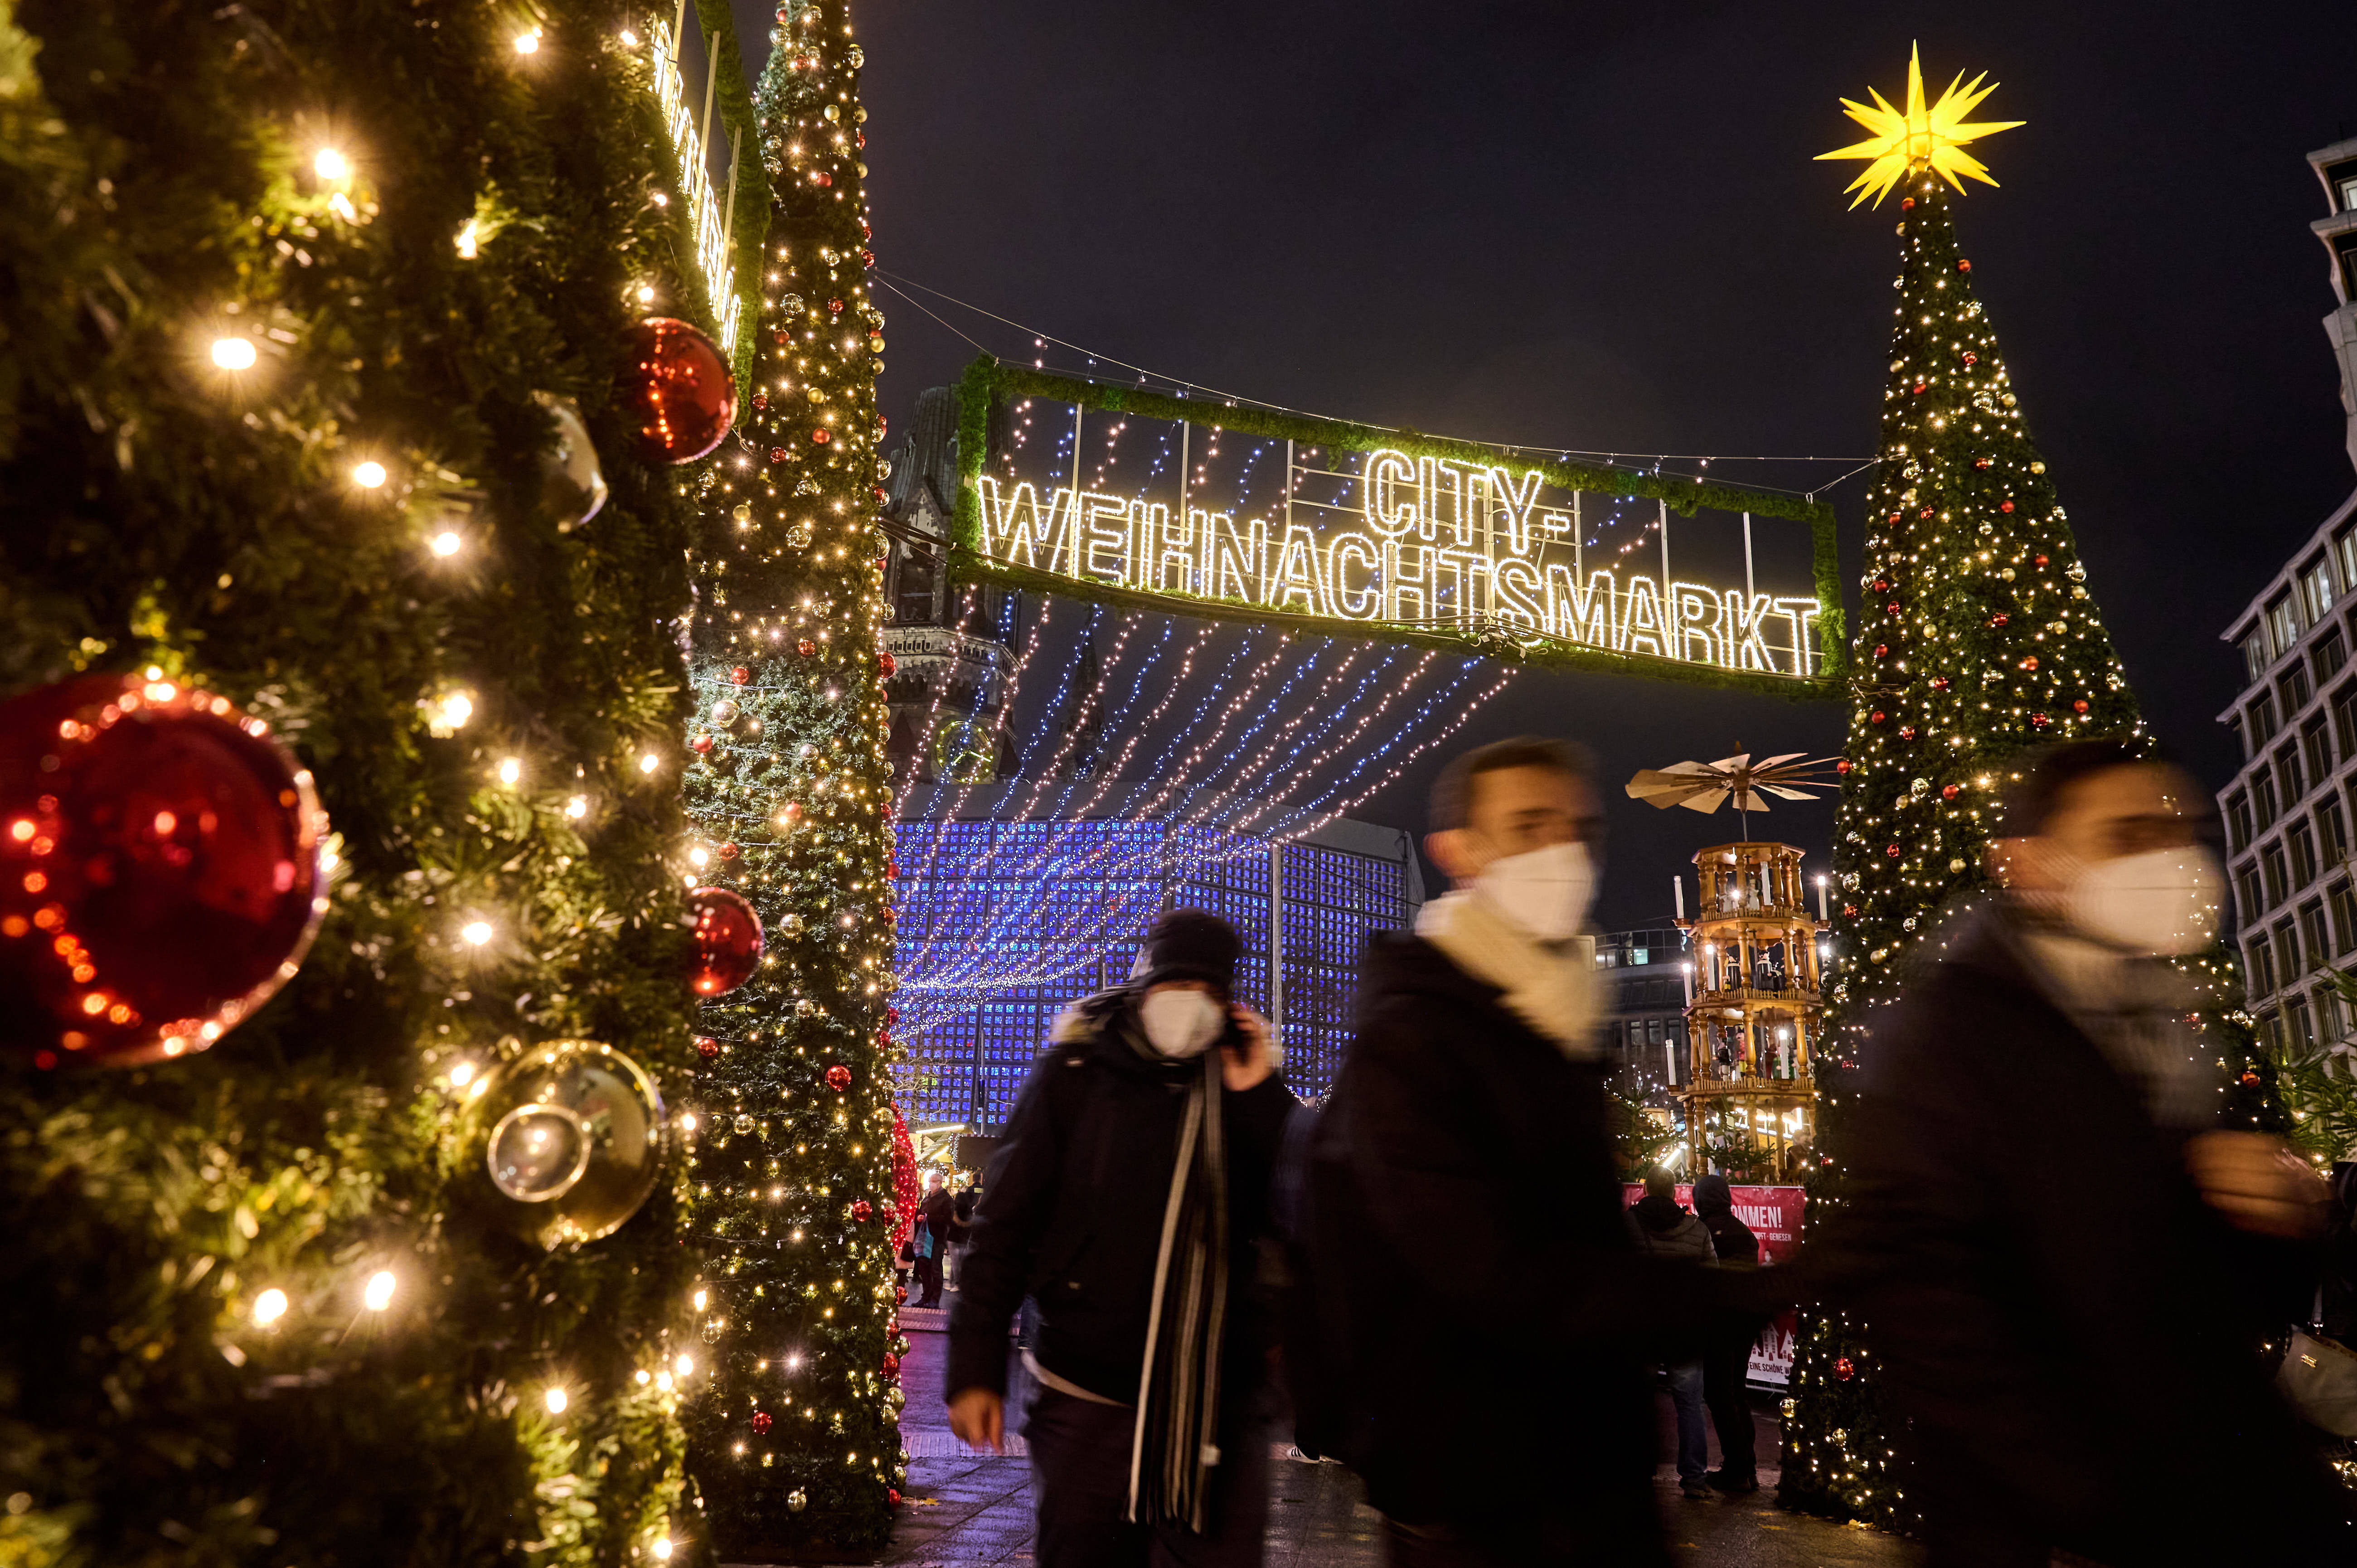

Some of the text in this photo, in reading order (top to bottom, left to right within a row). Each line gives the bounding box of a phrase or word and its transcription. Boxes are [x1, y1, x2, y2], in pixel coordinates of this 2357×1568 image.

[1364, 449, 1570, 555] CITY-
[977, 474, 1822, 676] WEIHNACHTSMARKT
[1769, 1232, 1792, 1242] GENESEN
[1749, 1361, 1761, 1371] EINE
[1762, 1363, 1784, 1374] SCHÖNE
